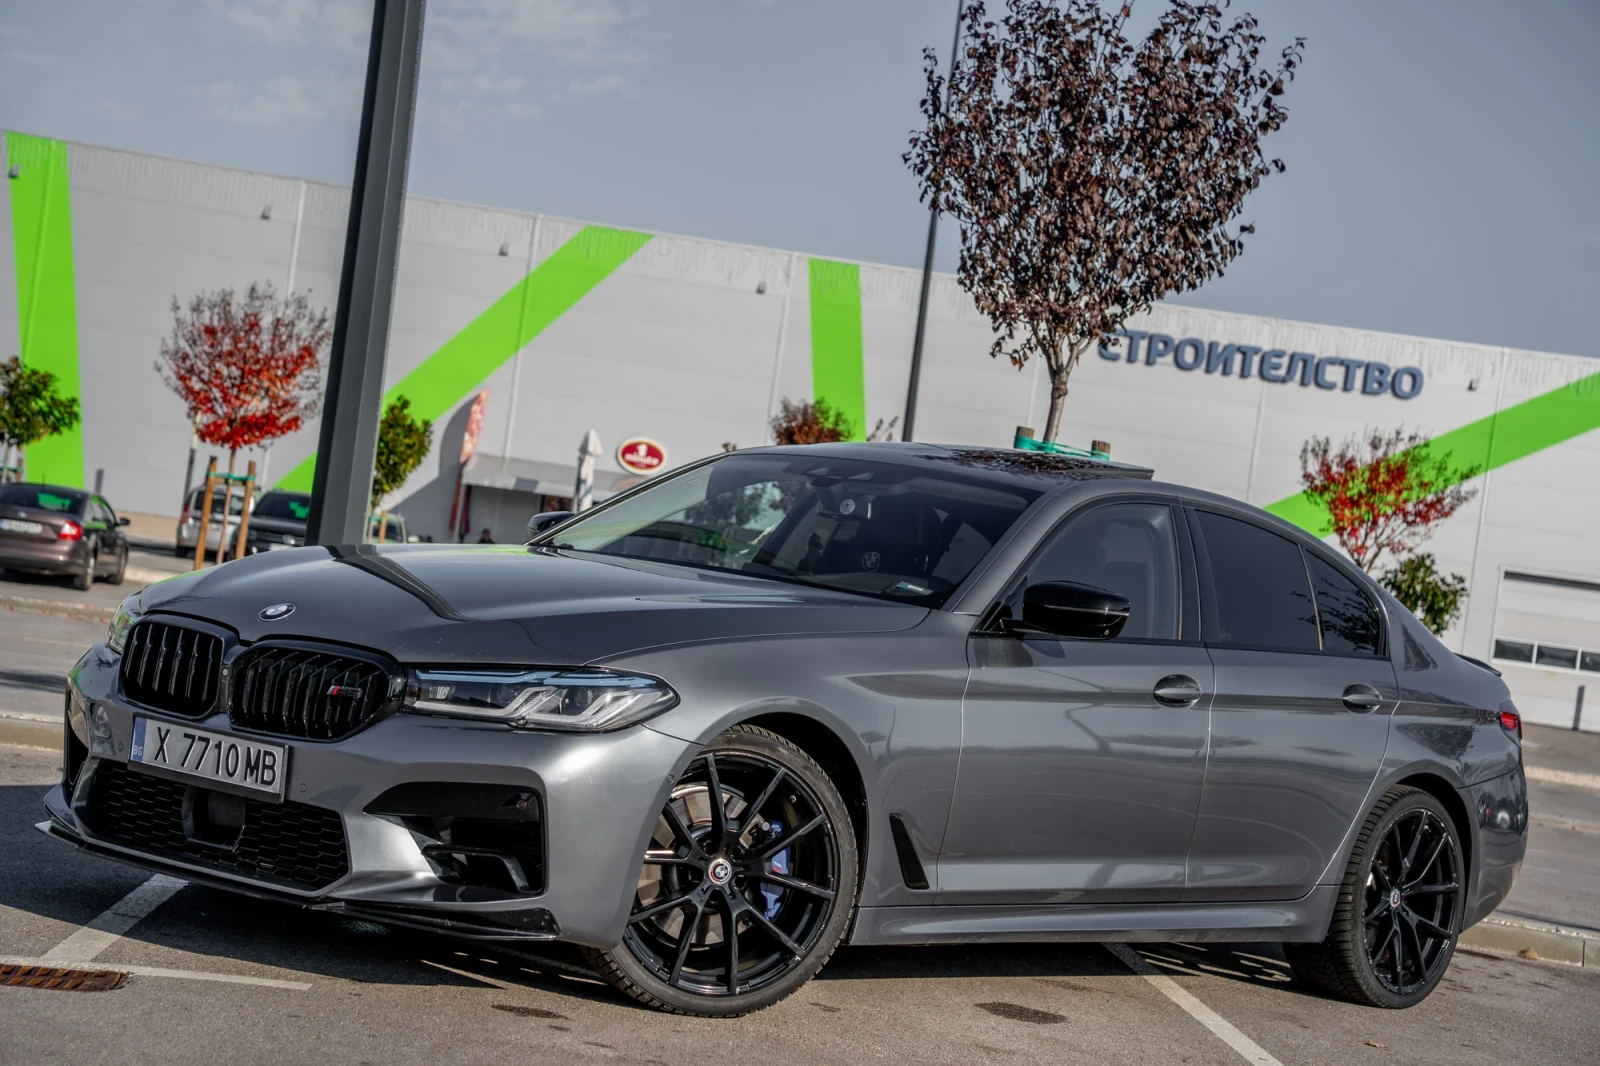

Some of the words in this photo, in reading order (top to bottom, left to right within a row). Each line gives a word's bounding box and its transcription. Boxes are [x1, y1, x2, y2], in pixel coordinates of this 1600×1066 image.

[1097, 328, 1424, 400] СТРОИТЕЛСТВО
[132, 745, 143, 756] BG
[154, 726, 170, 763] X
[180, 732, 241, 778] 7710
[244, 746, 278, 786] MB
